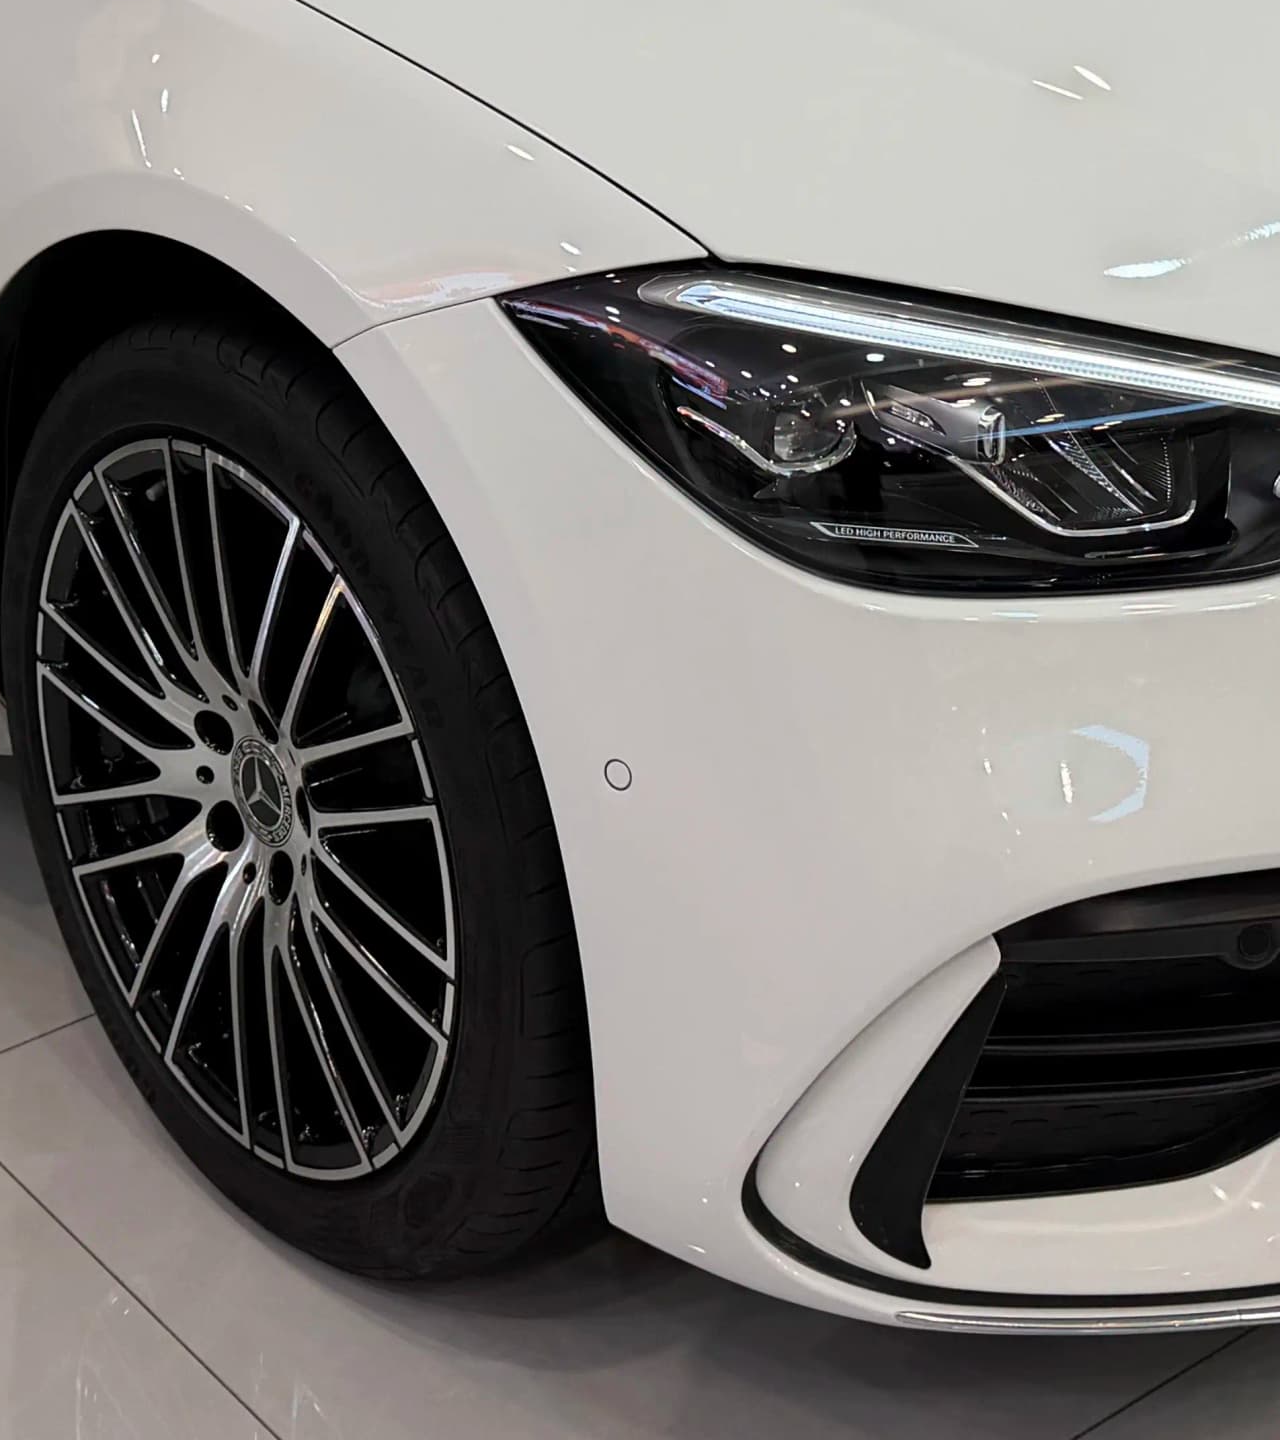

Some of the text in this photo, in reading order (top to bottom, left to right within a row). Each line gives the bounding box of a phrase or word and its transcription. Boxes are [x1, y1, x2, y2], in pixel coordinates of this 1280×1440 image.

[834, 526, 956, 543] LED HIGH PERFORMANCE
